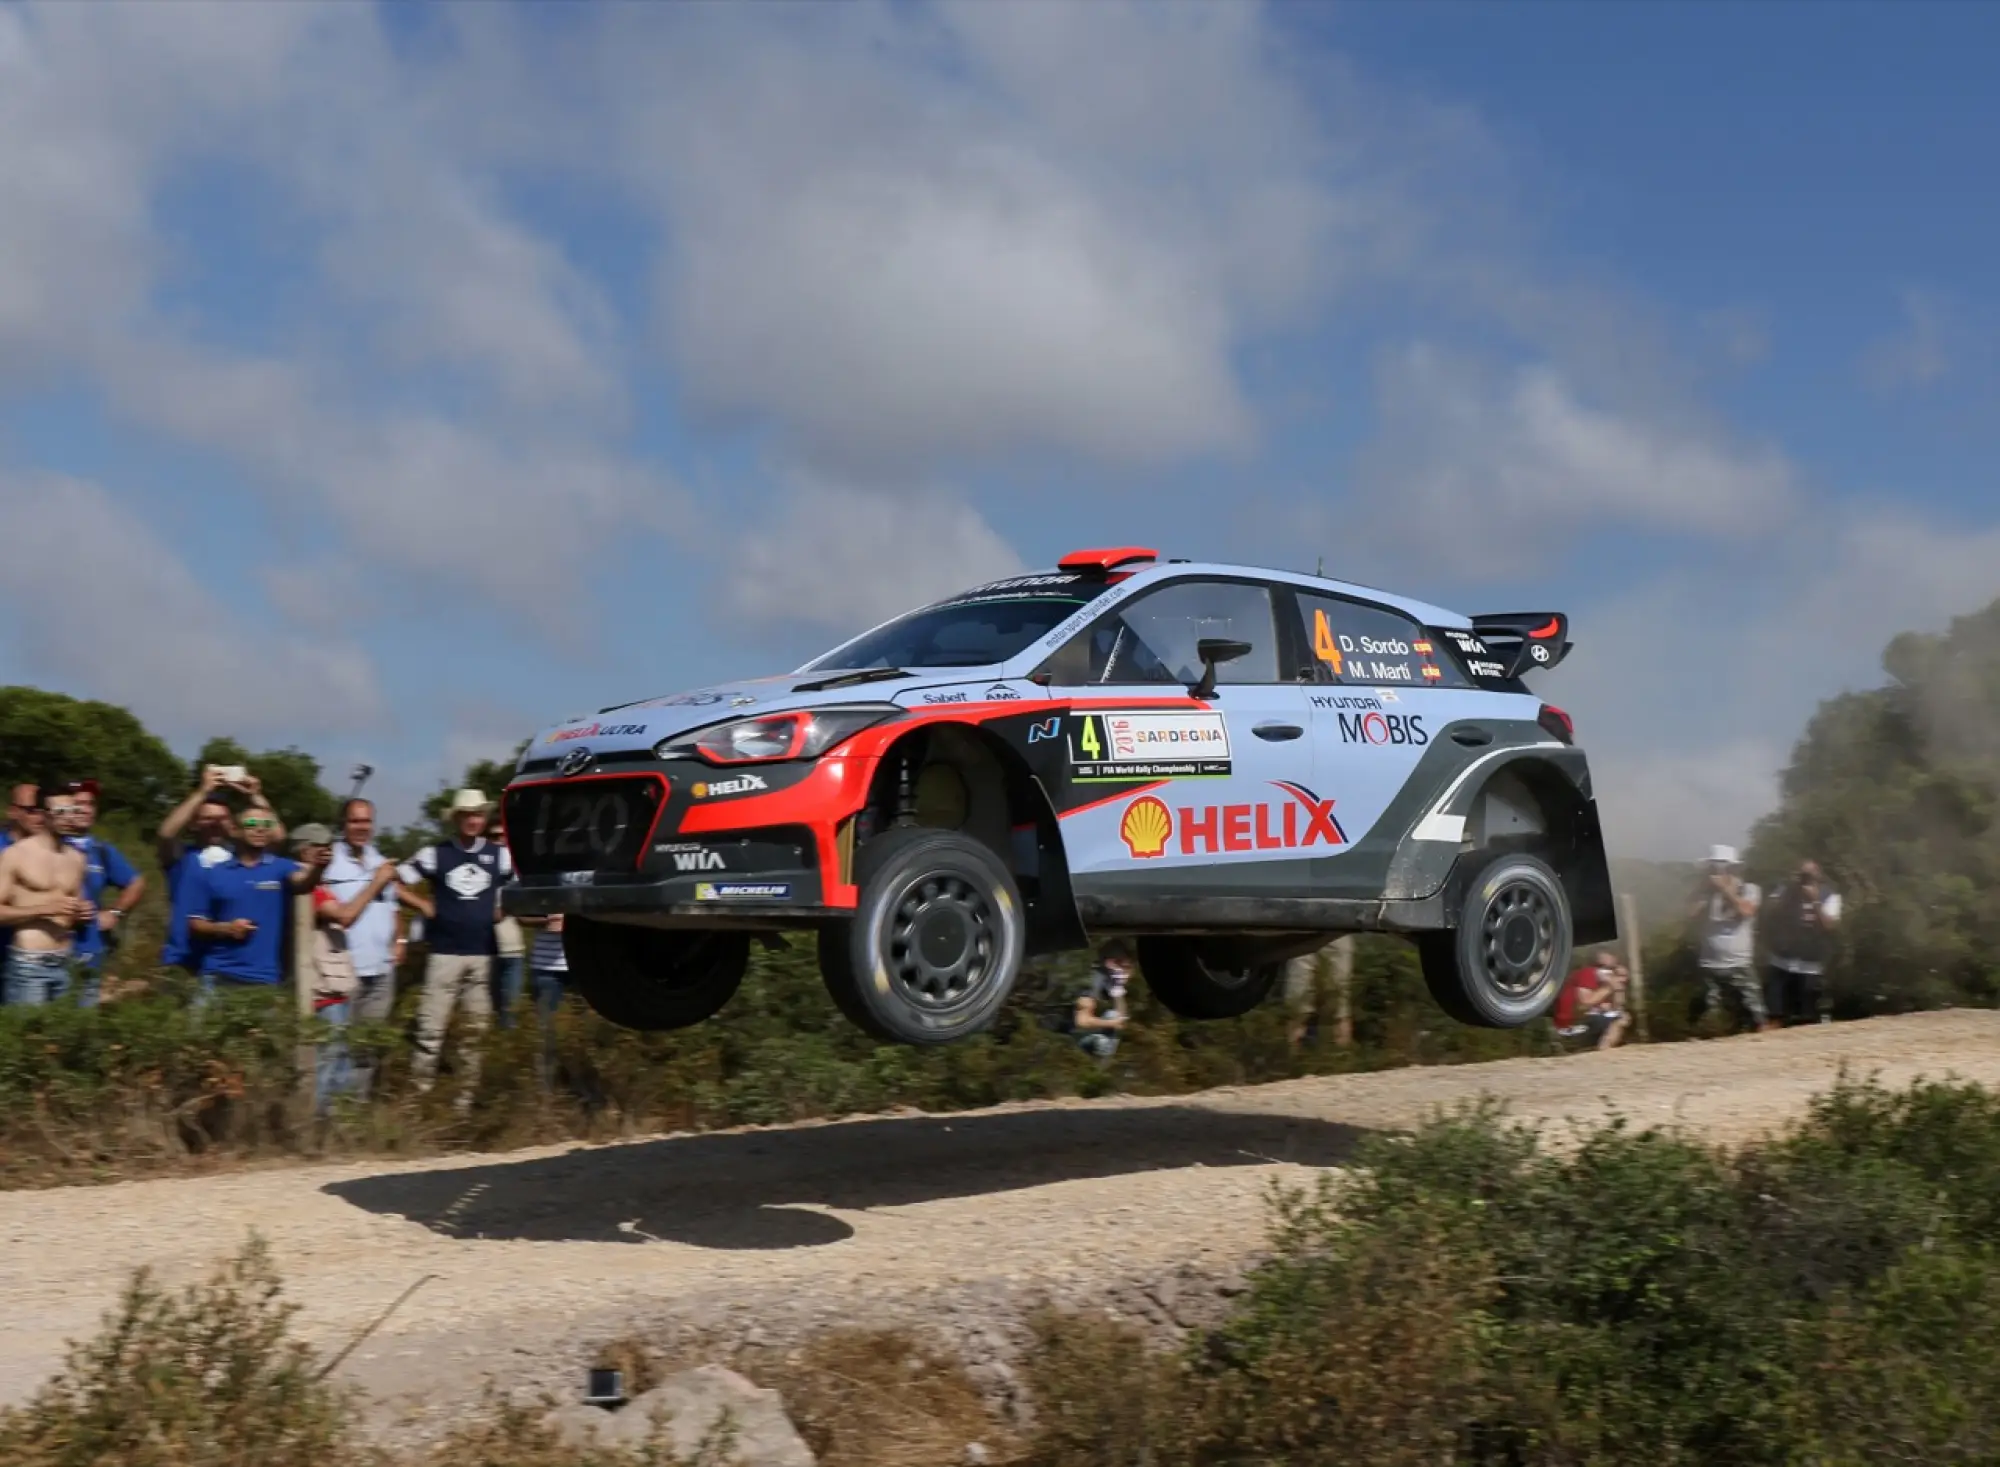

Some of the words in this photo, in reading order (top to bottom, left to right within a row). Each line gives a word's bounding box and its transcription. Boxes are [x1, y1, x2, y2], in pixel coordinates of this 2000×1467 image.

[1315, 608, 1343, 675] 4
[1339, 635, 1359, 653] D.
[1360, 636, 1409, 656] Sordo
[1348, 661, 1370, 679] M.
[1371, 661, 1412, 681] Martí
[1310, 696, 1382, 710] HYUNDAI
[1080, 715, 1101, 760] 4
[1112, 720, 1135, 754] 2016
[1136, 729, 1223, 744] SARDEGNA
[1337, 711, 1429, 746] MOBIS
[708, 774, 769, 796] HELIX
[1177, 779, 1350, 855] HELIX
